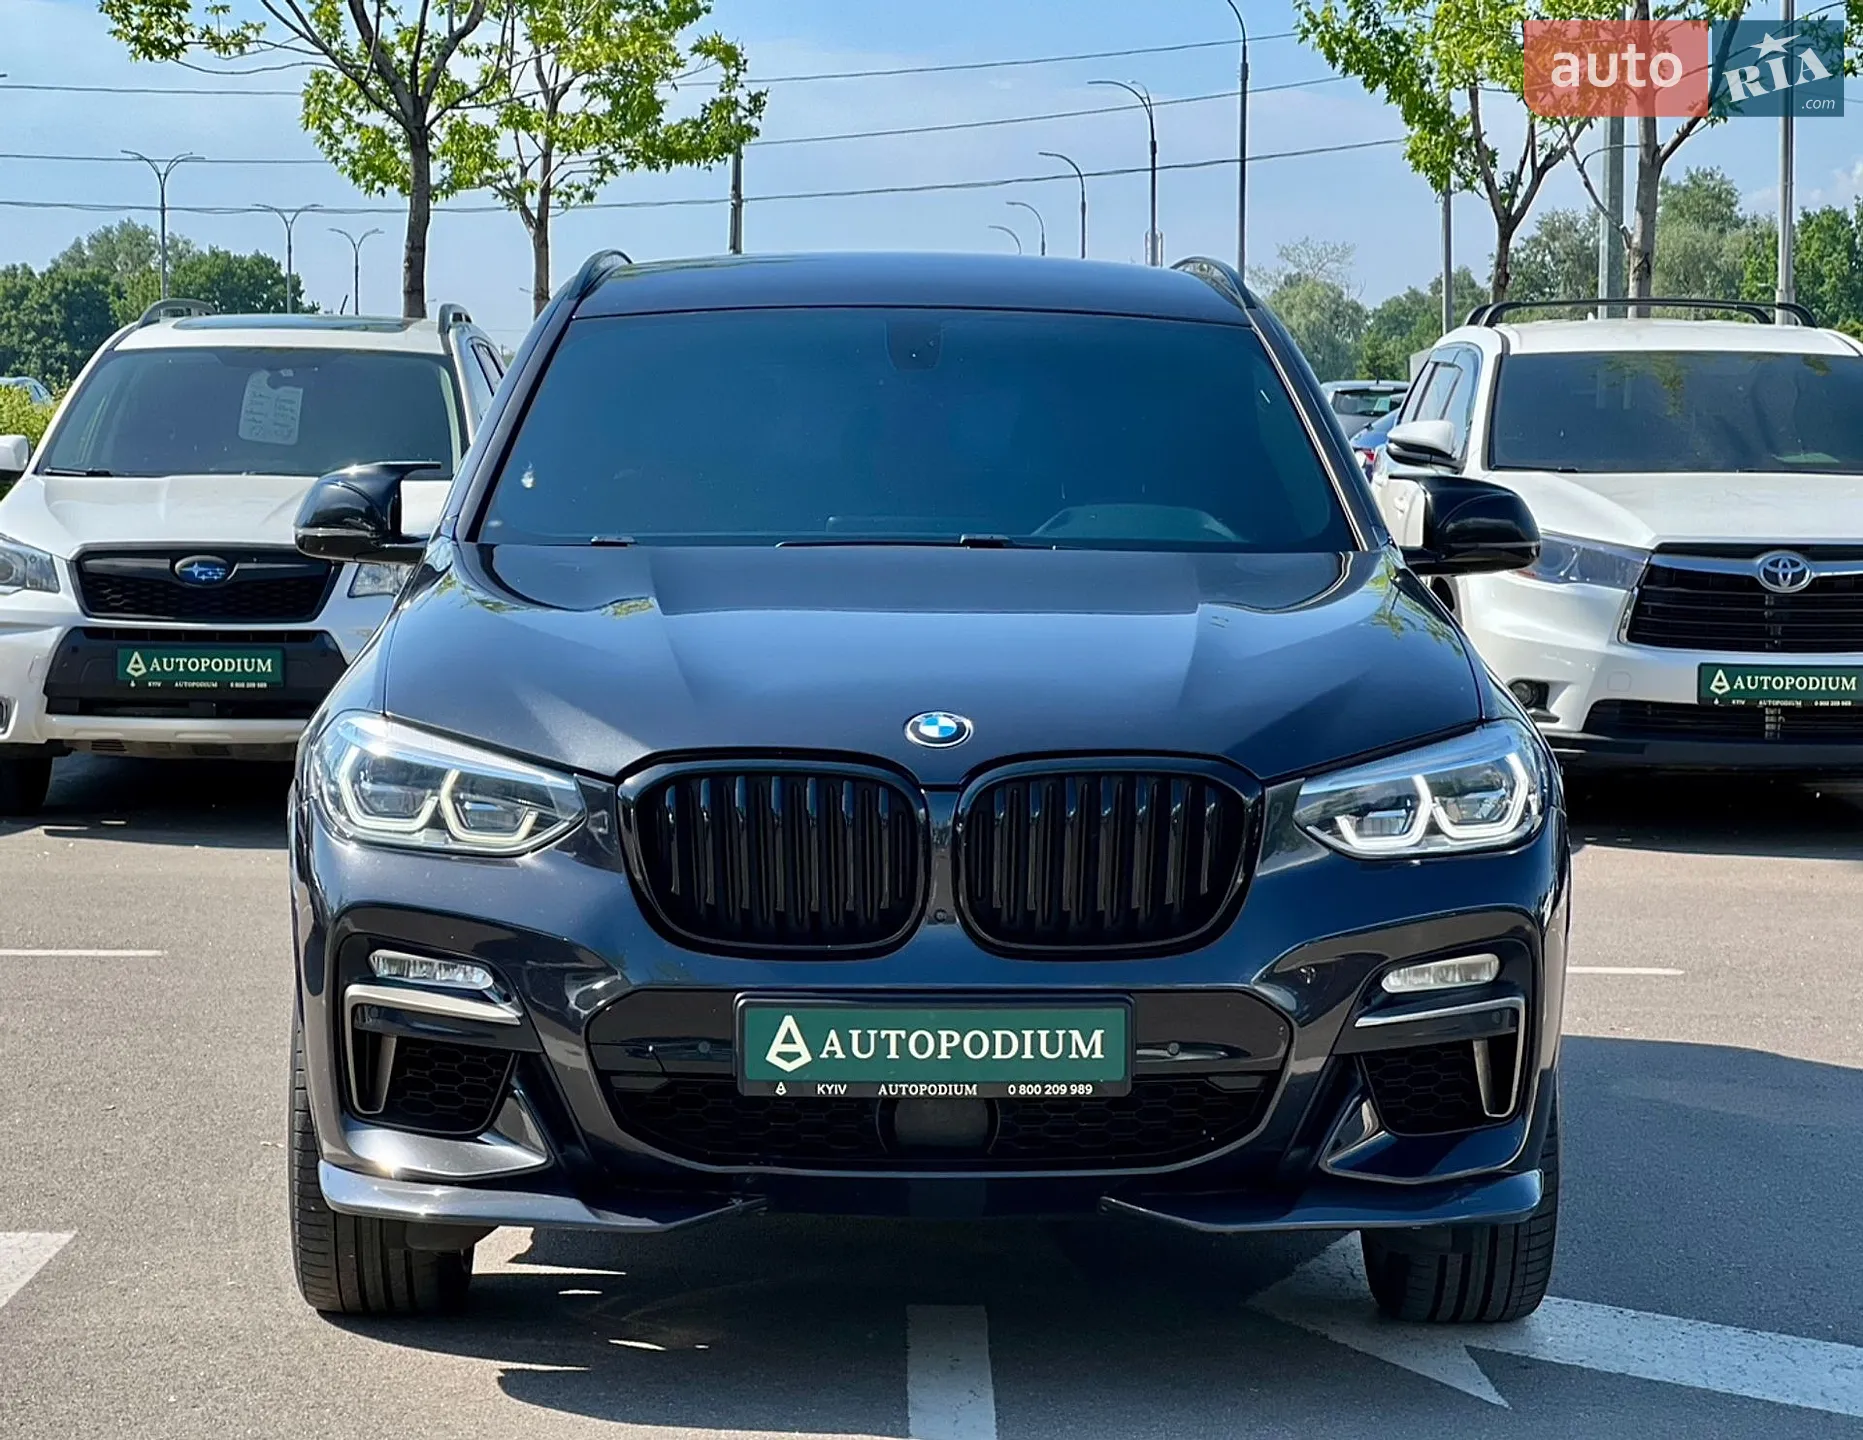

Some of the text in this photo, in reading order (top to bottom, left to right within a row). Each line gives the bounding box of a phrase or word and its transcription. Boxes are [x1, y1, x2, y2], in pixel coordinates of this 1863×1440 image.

[150, 657, 273, 673] AUTOPODIUM
[1733, 675, 1857, 691] AUTOPODIUM
[819, 1028, 1105, 1060] AUTOPODIUM
[817, 1083, 1093, 1096] KYIV AUTOPODIUM 0 800 209 989
